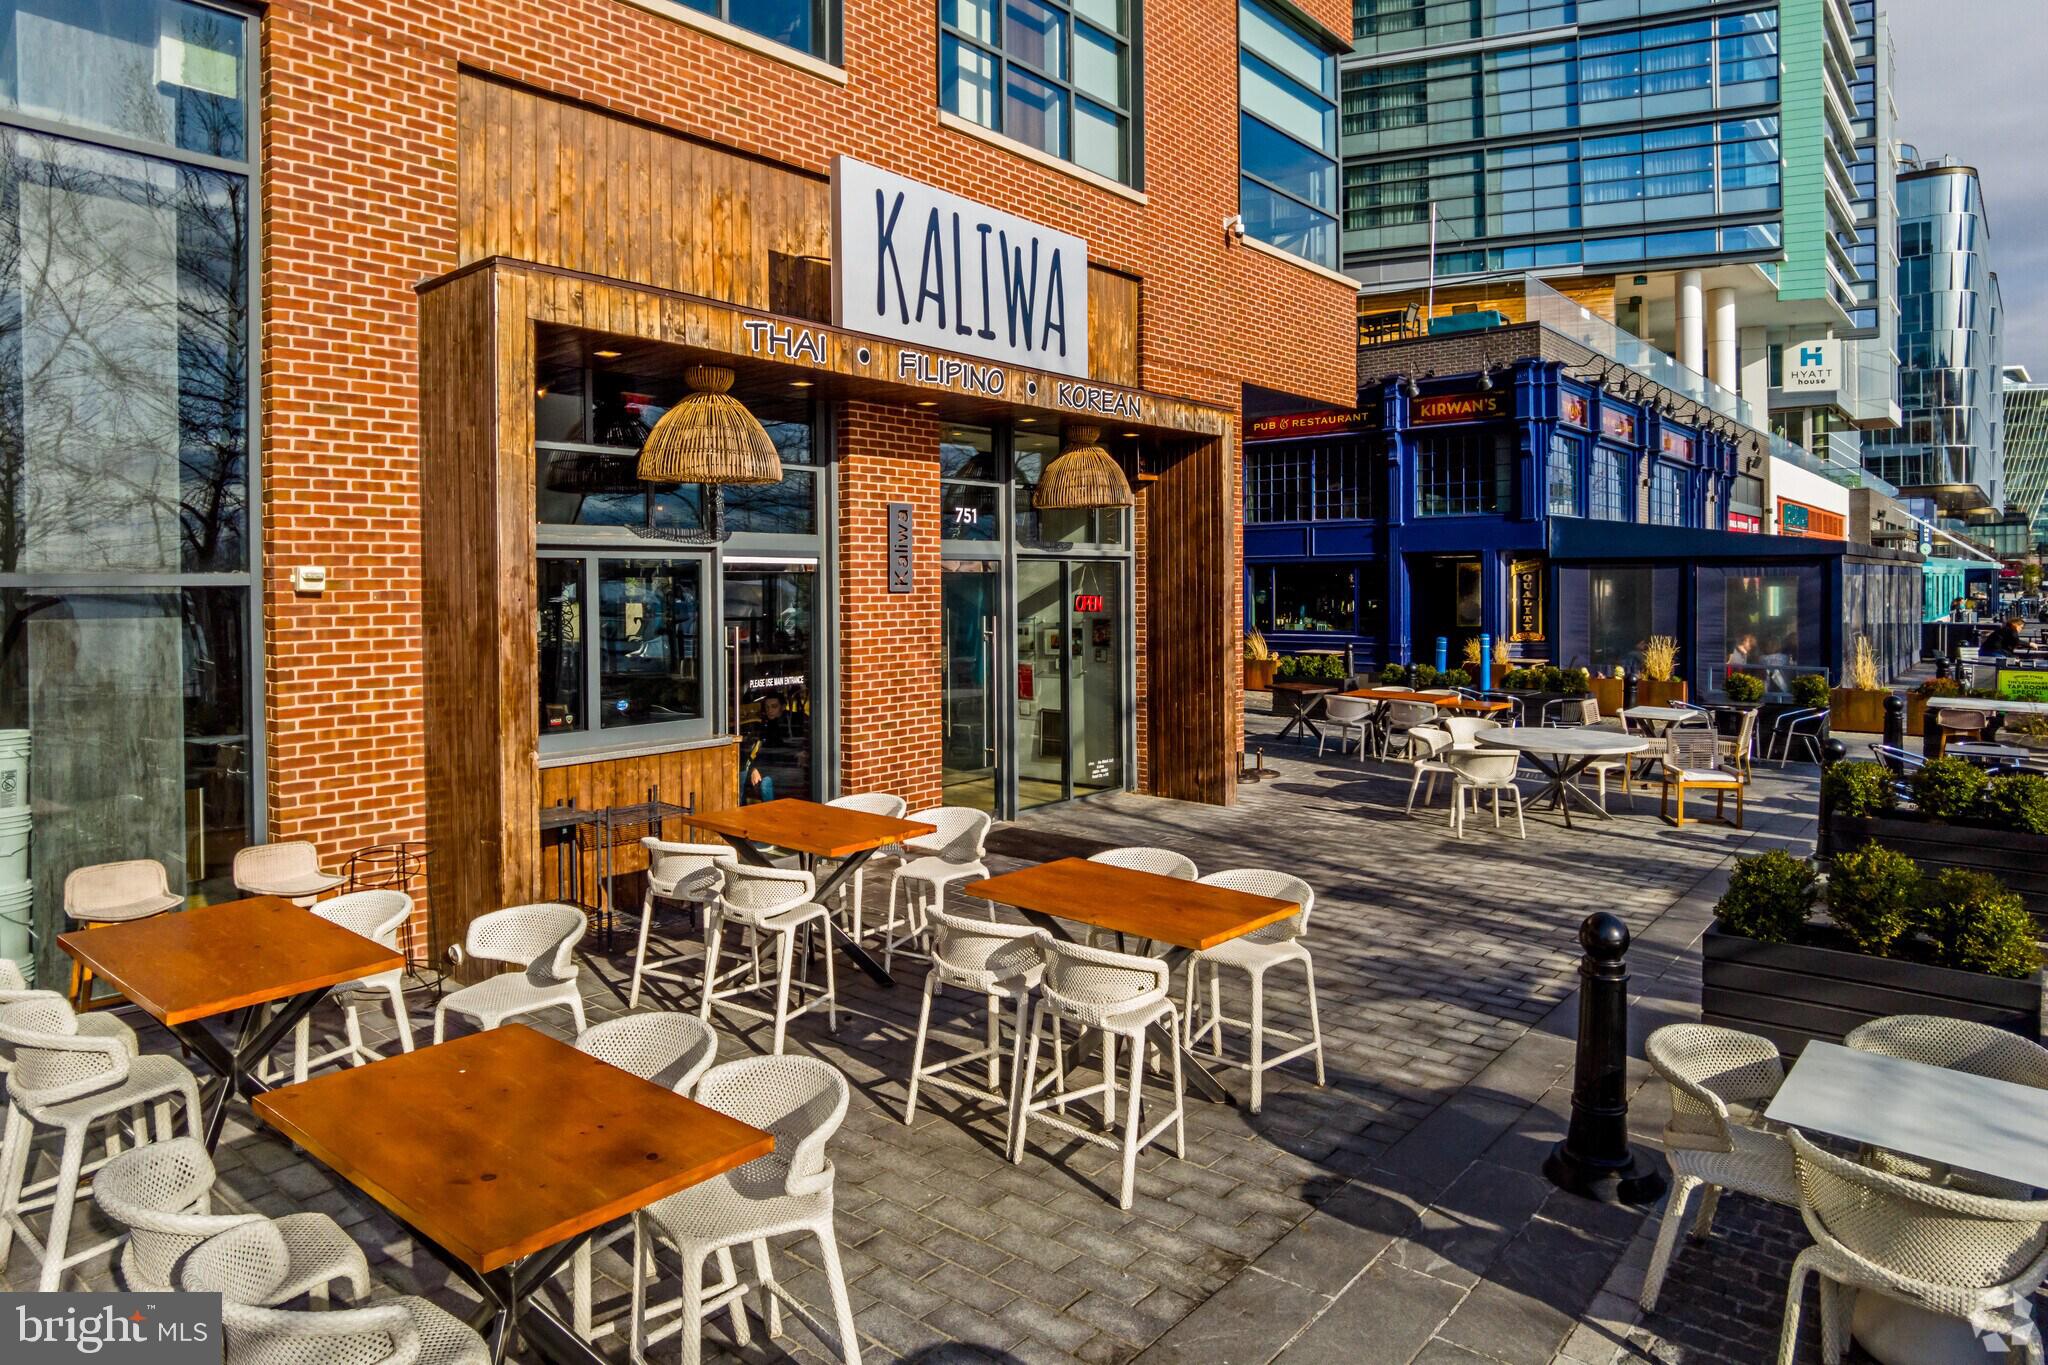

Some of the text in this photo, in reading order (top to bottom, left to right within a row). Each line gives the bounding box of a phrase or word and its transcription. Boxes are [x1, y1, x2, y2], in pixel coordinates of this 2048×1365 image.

[875, 187, 1066, 358] KALIWA
[744, 320, 1142, 419] THAI FILIPINO KOREAN
[1791, 369, 1833, 379] HYATT
[1421, 398, 1497, 417] KIRWAN'S
[1253, 421, 1277, 431] PUB
[1292, 412, 1369, 428] RESTAURANT
[955, 506, 978, 524] 751
[894, 509, 909, 586] Kaliwa
[1075, 595, 1104, 612] OPEN
[1522, 573, 1533, 631] QUALITY
[749, 675, 804, 688] PLEASE USE MAIN ENTRANCE
